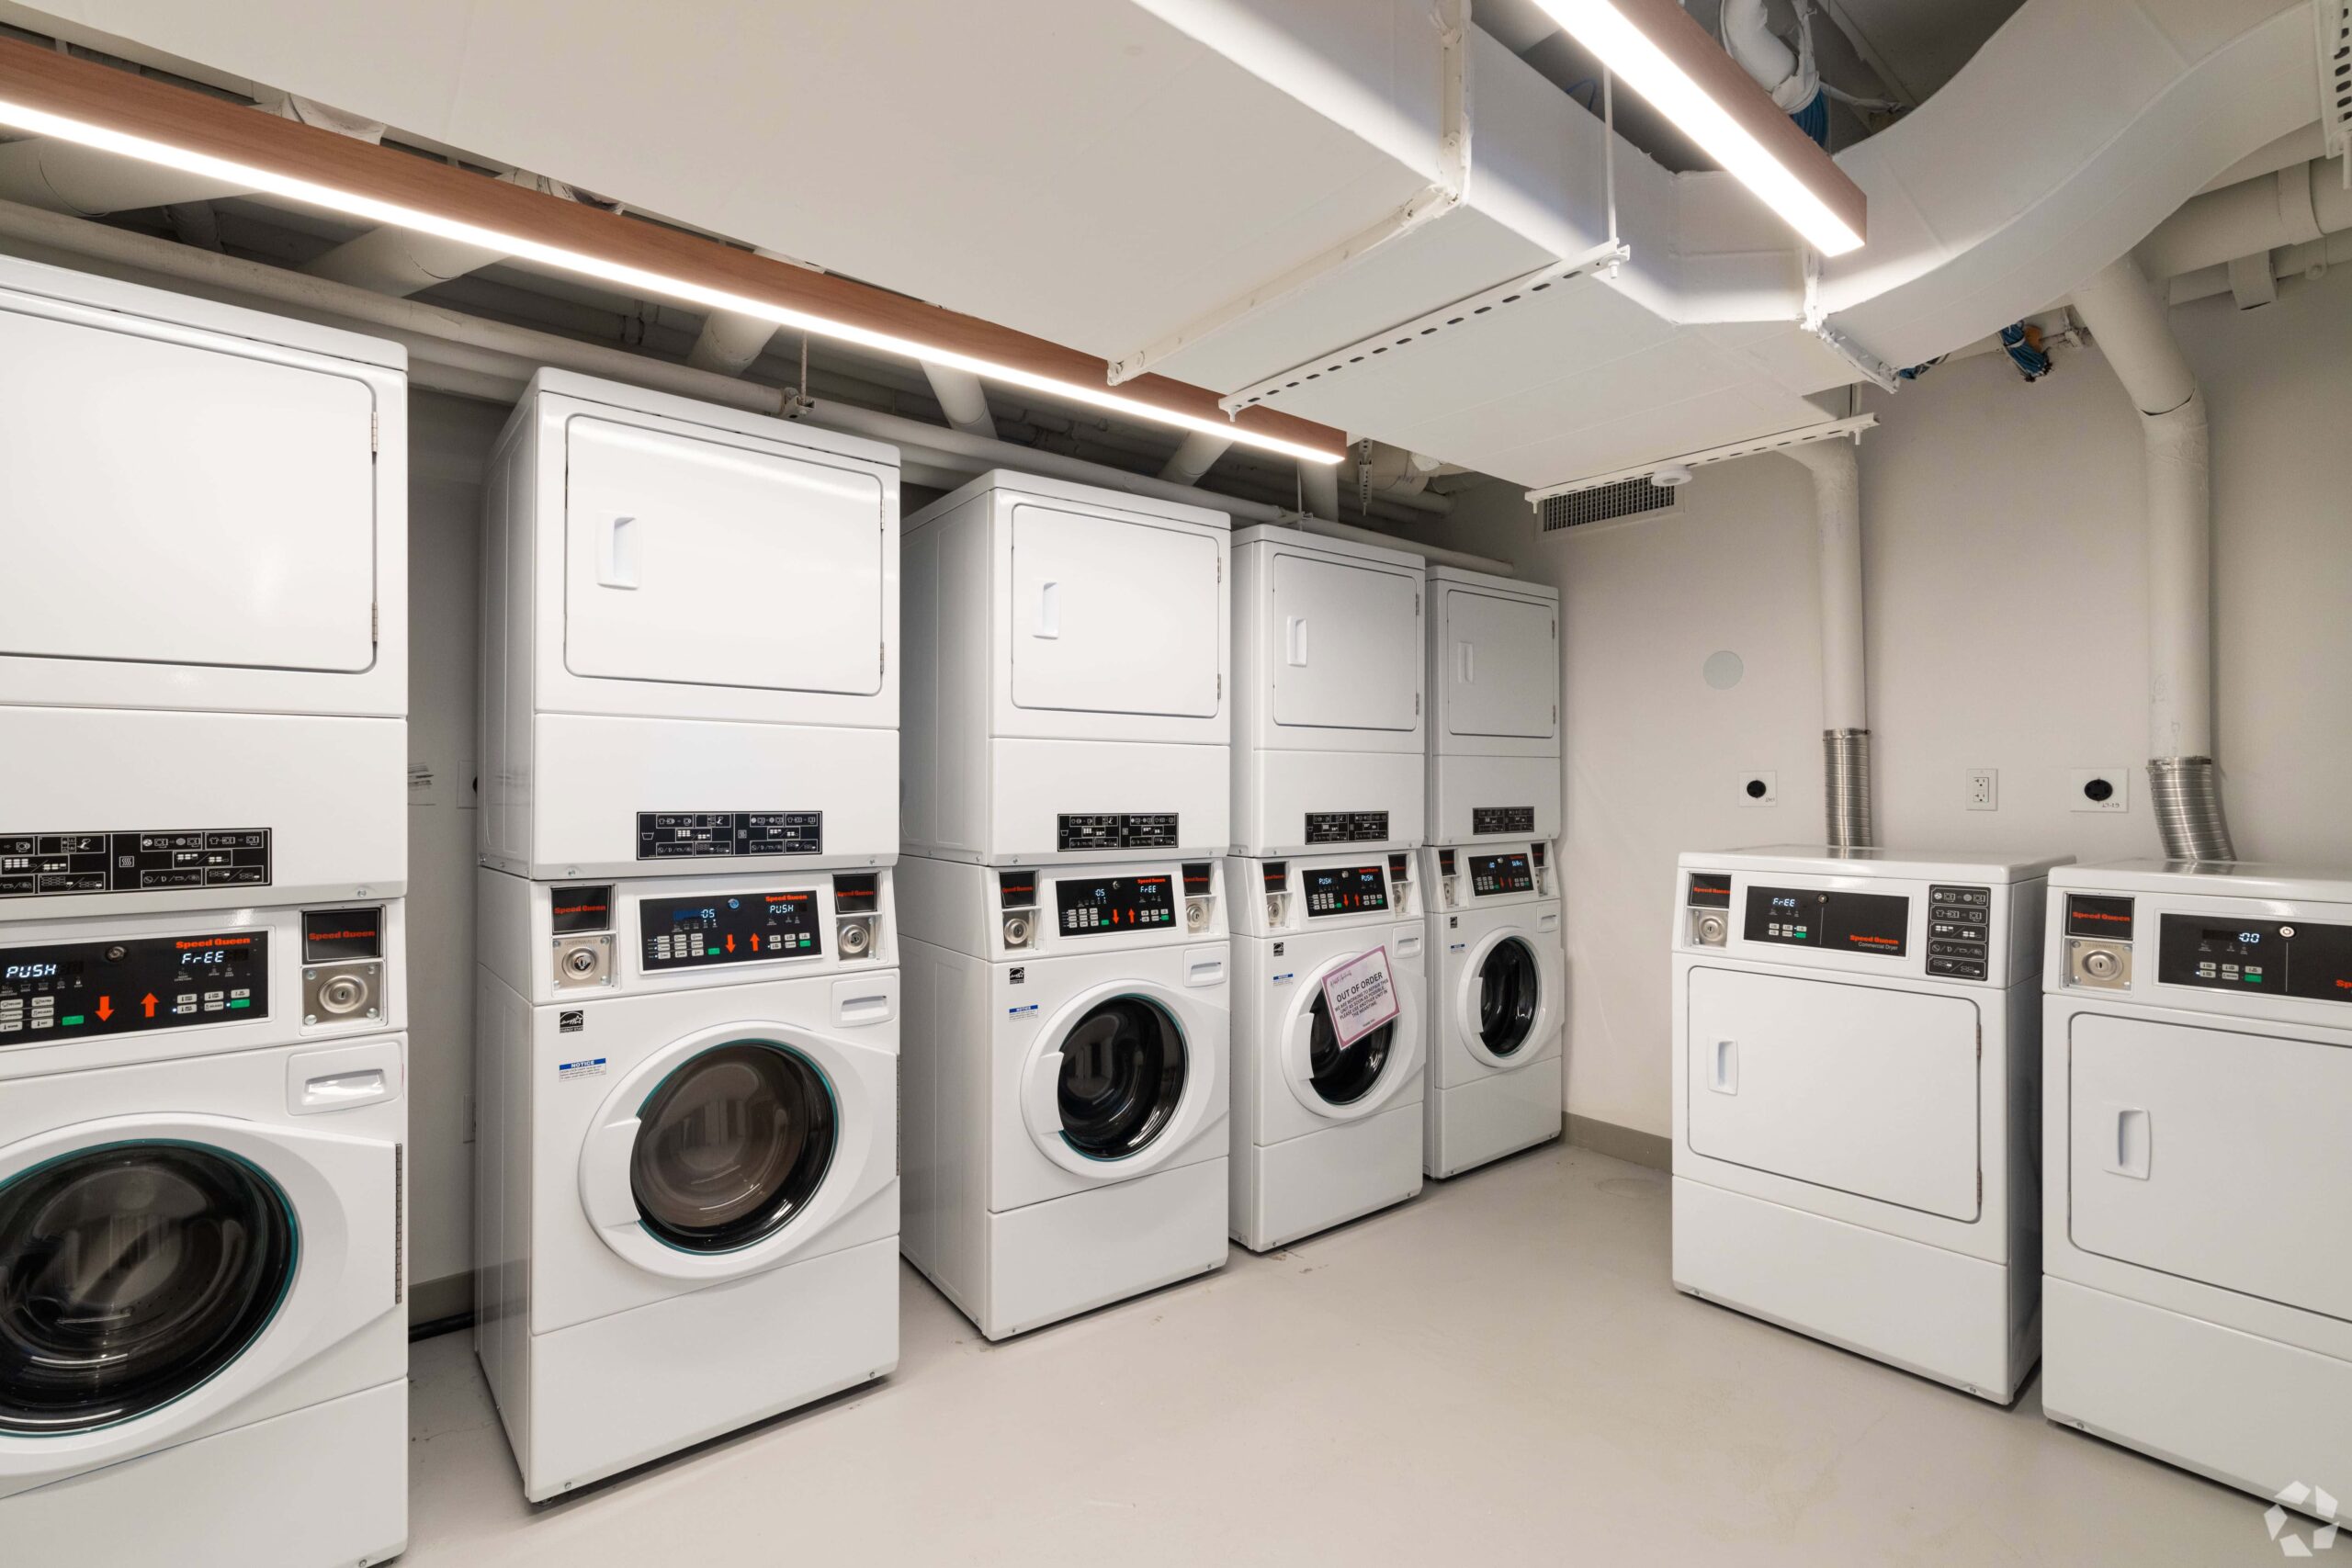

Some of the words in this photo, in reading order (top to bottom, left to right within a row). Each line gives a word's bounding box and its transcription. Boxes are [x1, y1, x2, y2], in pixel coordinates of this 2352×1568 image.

[554, 906, 581, 915] Speed
[769, 904, 794, 914] PUSH
[2073, 911, 2100, 919] Speed
[308, 931, 342, 941] Speed
[343, 930, 375, 938] Queen
[175, 940, 212, 949] Speed
[214, 938, 250, 946] Queen
[6, 964, 57, 978] PUSH
[1337, 988, 1350, 1003] OUT
[1351, 984, 1360, 994] OF
[1361, 972, 1384, 989] ORDER
[571, 1060, 594, 1068] NOTICE
